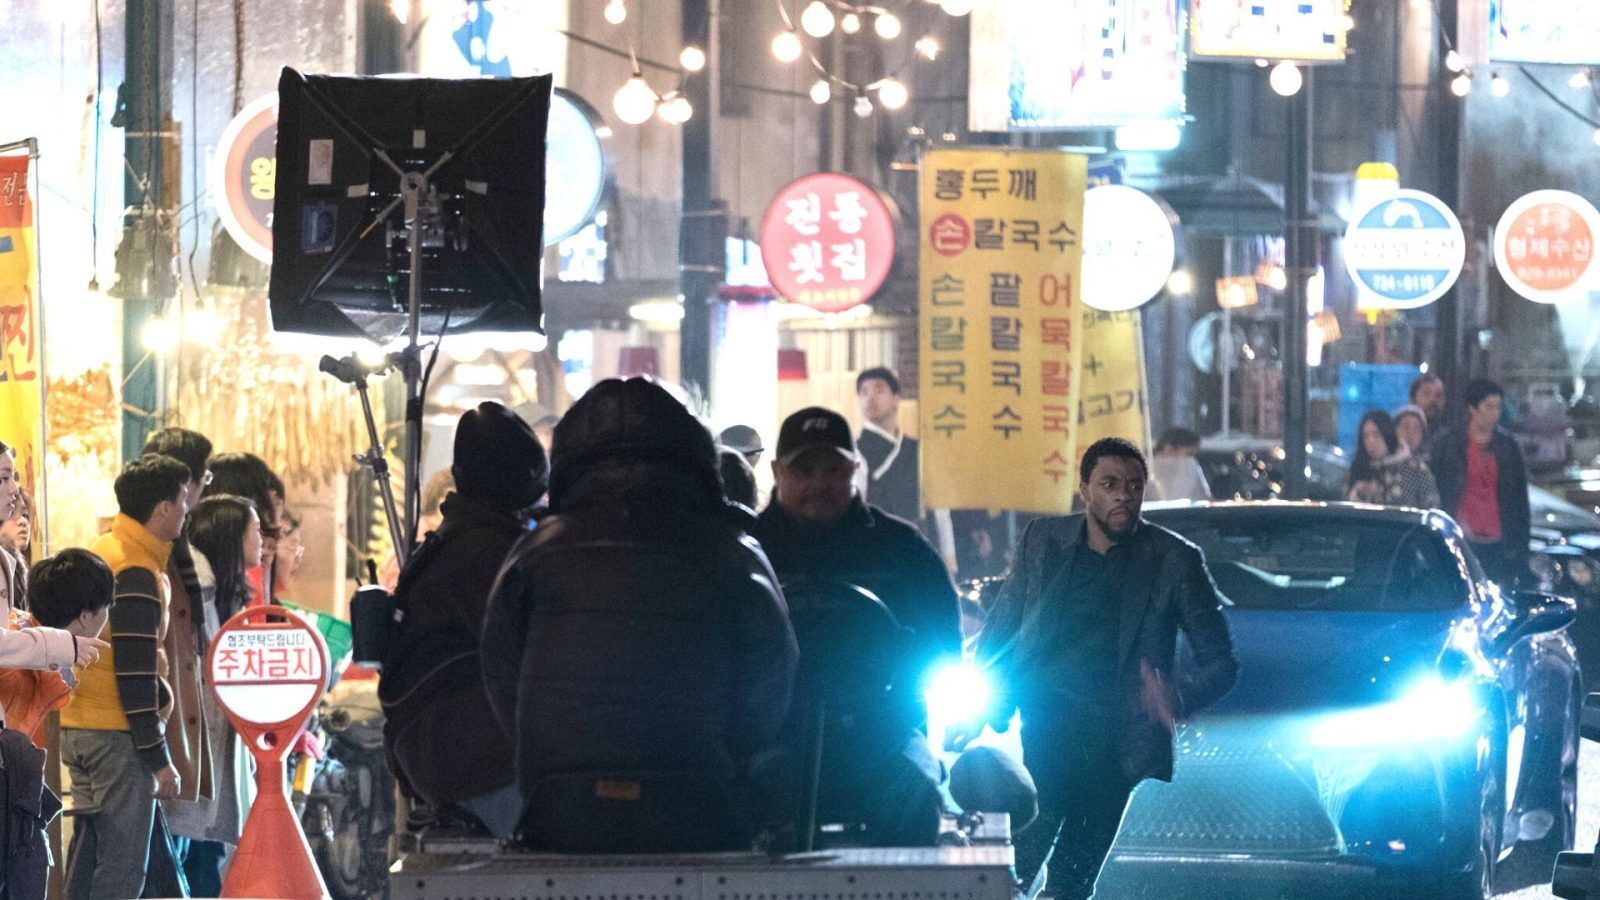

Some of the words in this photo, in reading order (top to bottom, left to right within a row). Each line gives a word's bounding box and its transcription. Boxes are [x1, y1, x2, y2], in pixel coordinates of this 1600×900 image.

[935, 168, 1037, 200] 홍두깨
[789, 238, 867, 284] 횟집
[931, 272, 968, 440] 손칼국수
[217, 647, 314, 679] 주차금지
